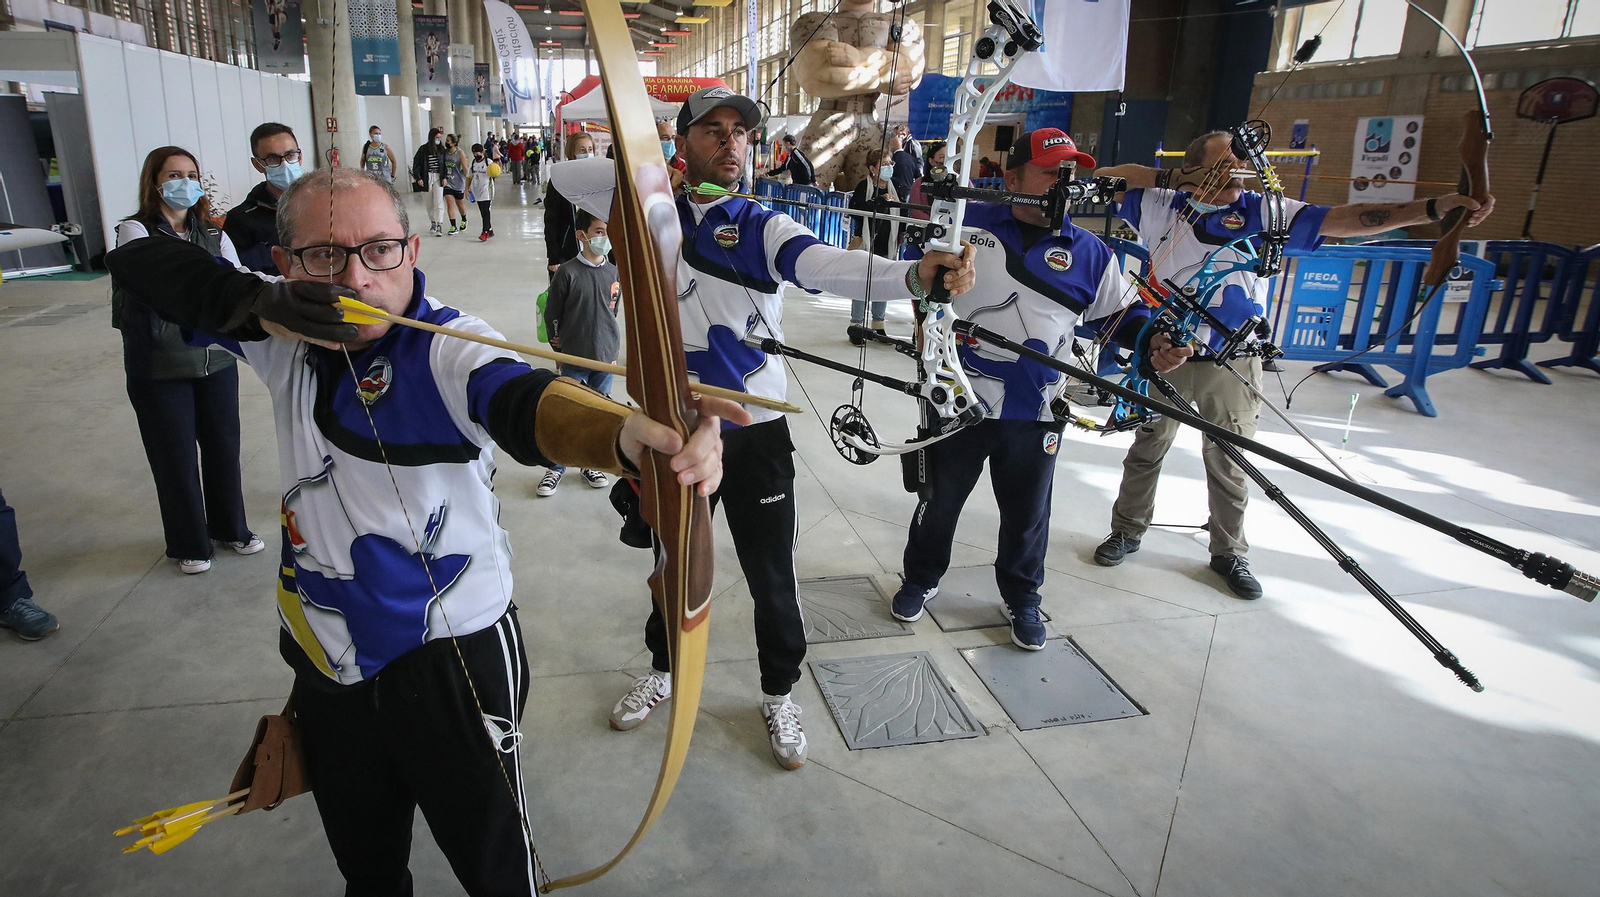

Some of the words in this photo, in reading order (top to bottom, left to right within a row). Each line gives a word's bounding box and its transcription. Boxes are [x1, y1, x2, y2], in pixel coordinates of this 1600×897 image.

[646, 84, 658, 94] DE
[660, 84, 703, 94] ARMADA
[1044, 137, 1074, 147] HOY
[1012, 196, 1040, 205] SHIBUYA
[969, 234, 996, 248] Bola
[1303, 272, 1339, 281] IFECA
[760, 493, 786, 504] adidas
